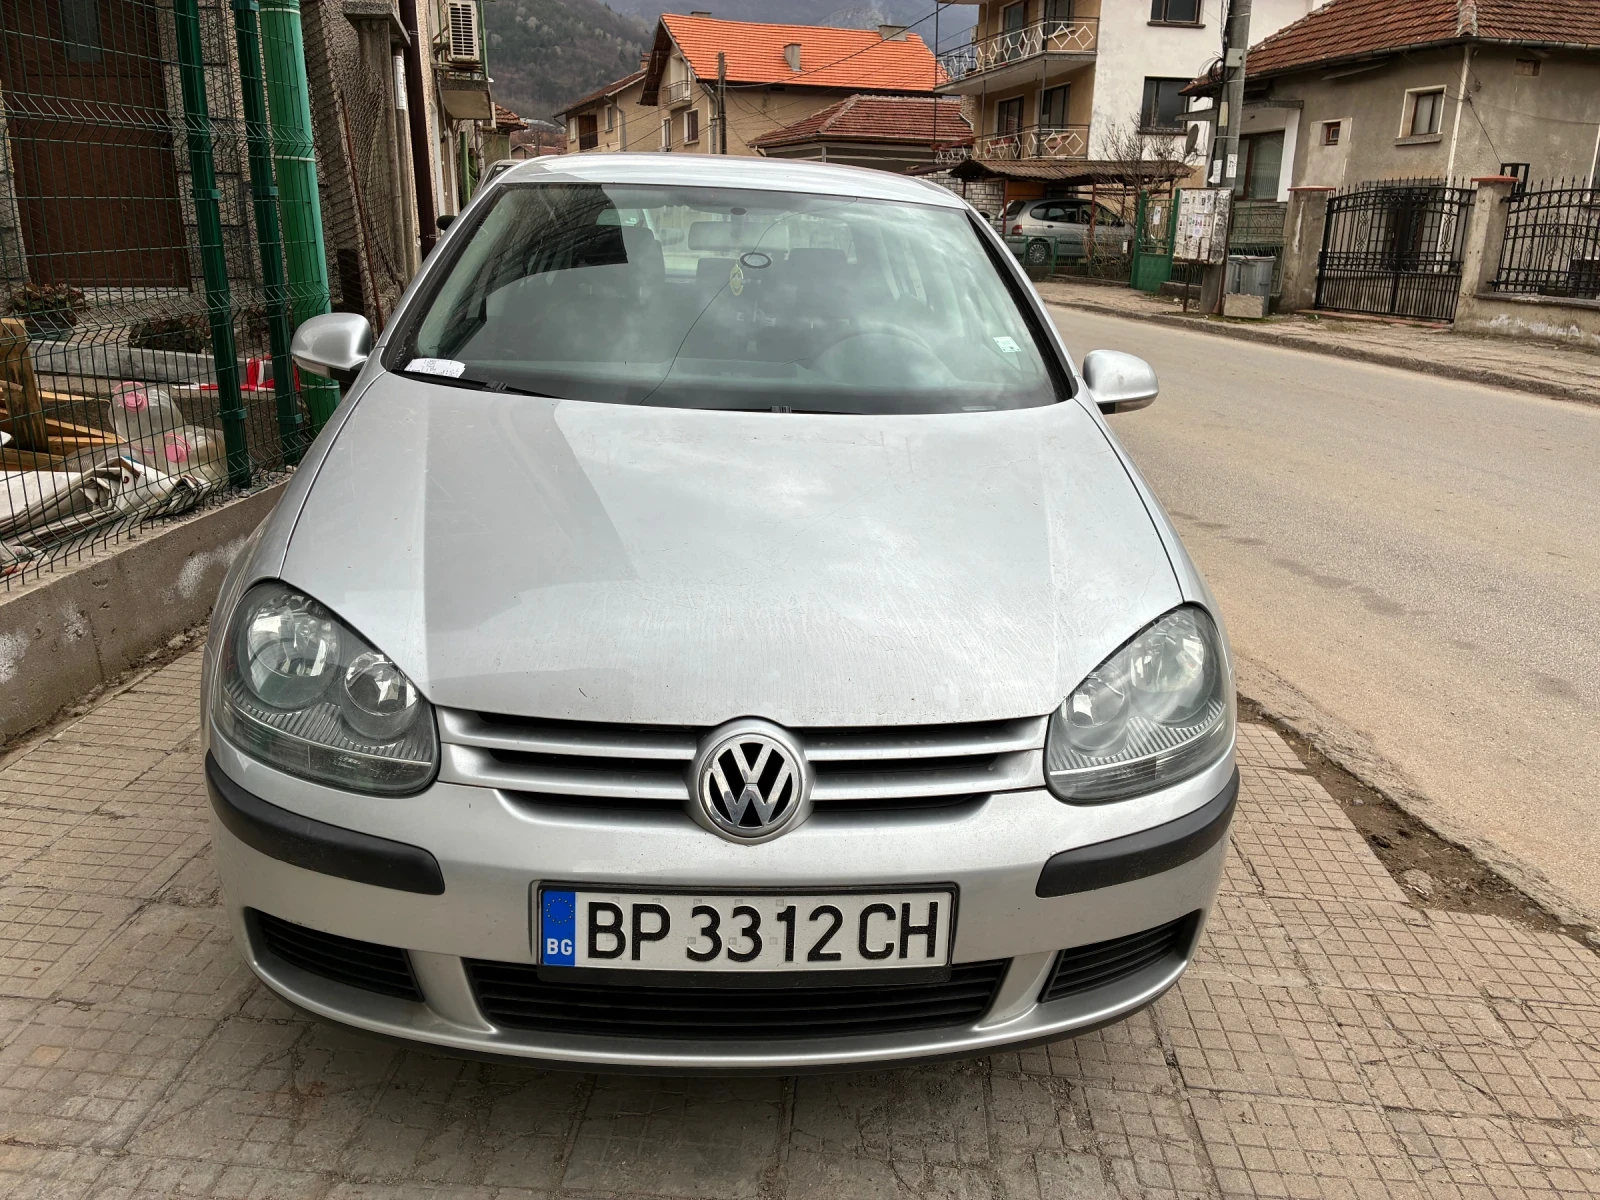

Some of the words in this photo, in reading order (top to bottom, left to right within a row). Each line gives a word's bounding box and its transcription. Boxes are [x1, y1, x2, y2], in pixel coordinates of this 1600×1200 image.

[703, 734, 800, 834] VW
[546, 938, 573, 956] BG
[588, 901, 671, 961] BP
[686, 904, 844, 963] 3312
[858, 901, 939, 960] CH
